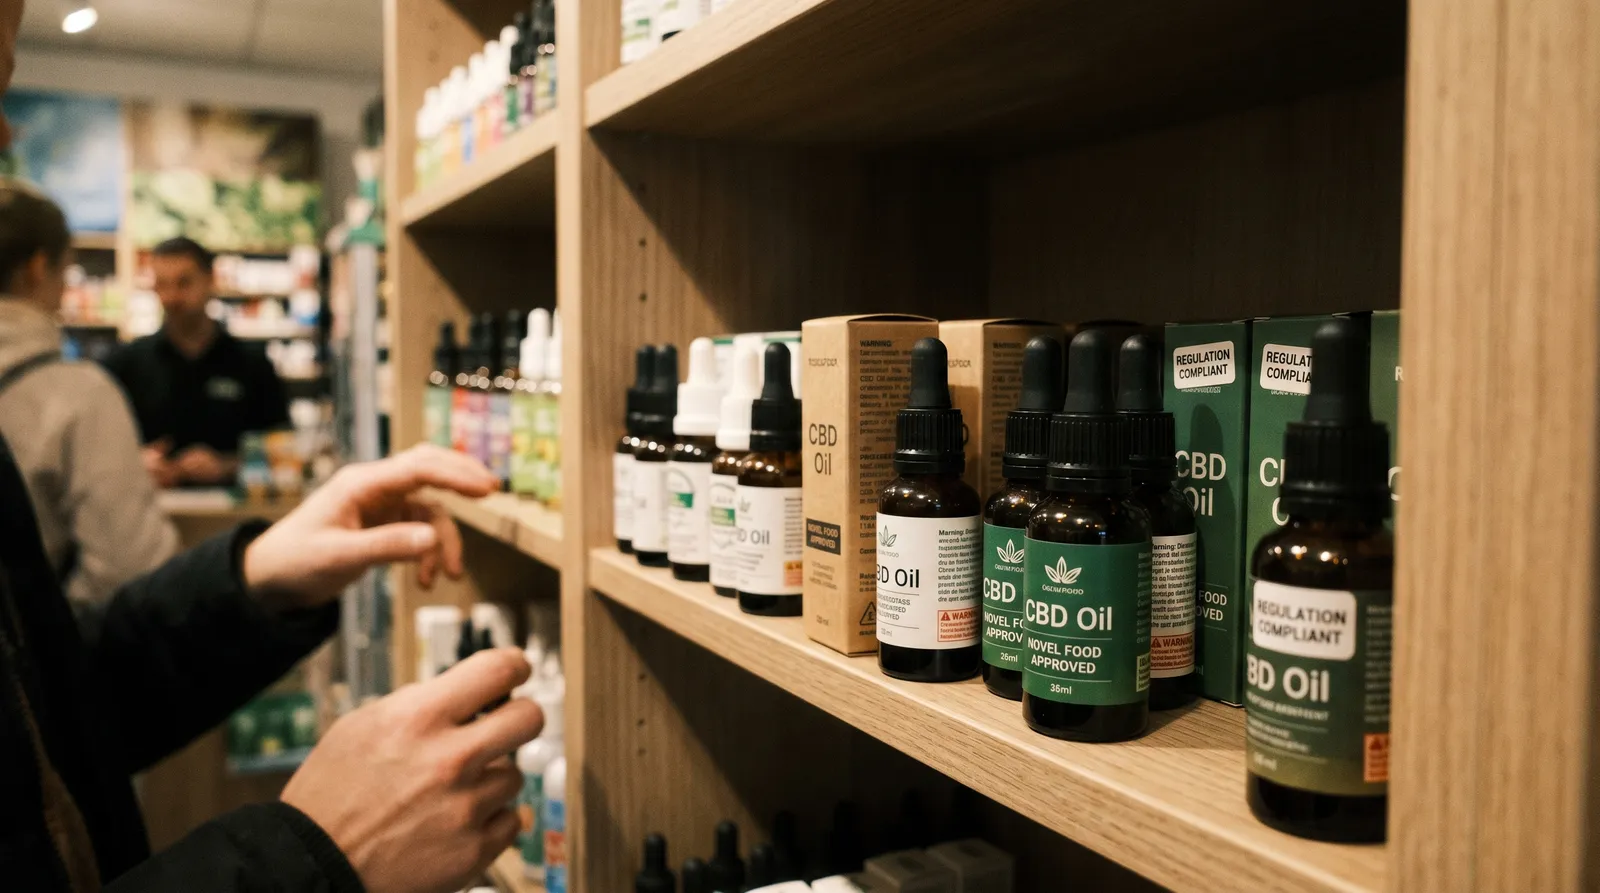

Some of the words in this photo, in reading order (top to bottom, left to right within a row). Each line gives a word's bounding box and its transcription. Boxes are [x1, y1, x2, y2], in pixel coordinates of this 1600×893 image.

[1176, 349, 1230, 366] REGULATION
[1266, 351, 1312, 367] REGULAT
[1179, 364, 1228, 379] COMPLIANT
[1267, 367, 1311, 383] COMPLIA
[809, 423, 837, 446] CBD
[814, 452, 831, 475] Oil
[1175, 450, 1226, 480] CBD
[750, 530, 770, 545] Oil
[823, 527, 839, 538] FOOD
[876, 564, 890, 584] BD
[895, 569, 919, 588] Oil
[983, 577, 1016, 603] CBD
[1198, 590, 1228, 606] FOOD
[984, 611, 1010, 628] NOVEL
[1026, 599, 1068, 628] CBD
[1077, 606, 1112, 631] Oil
[1195, 606, 1223, 621] OVED
[1257, 599, 1348, 626] REGULATION
[986, 626, 1023, 643] APPROV
[1259, 619, 1343, 645] COMPLIANT
[1028, 637, 1061, 656] NOVEL
[1064, 645, 1102, 658] FOOD
[1031, 654, 1096, 674] APPROVED
[1247, 654, 1276, 692] BD
[1283, 666, 1330, 703] Oil
